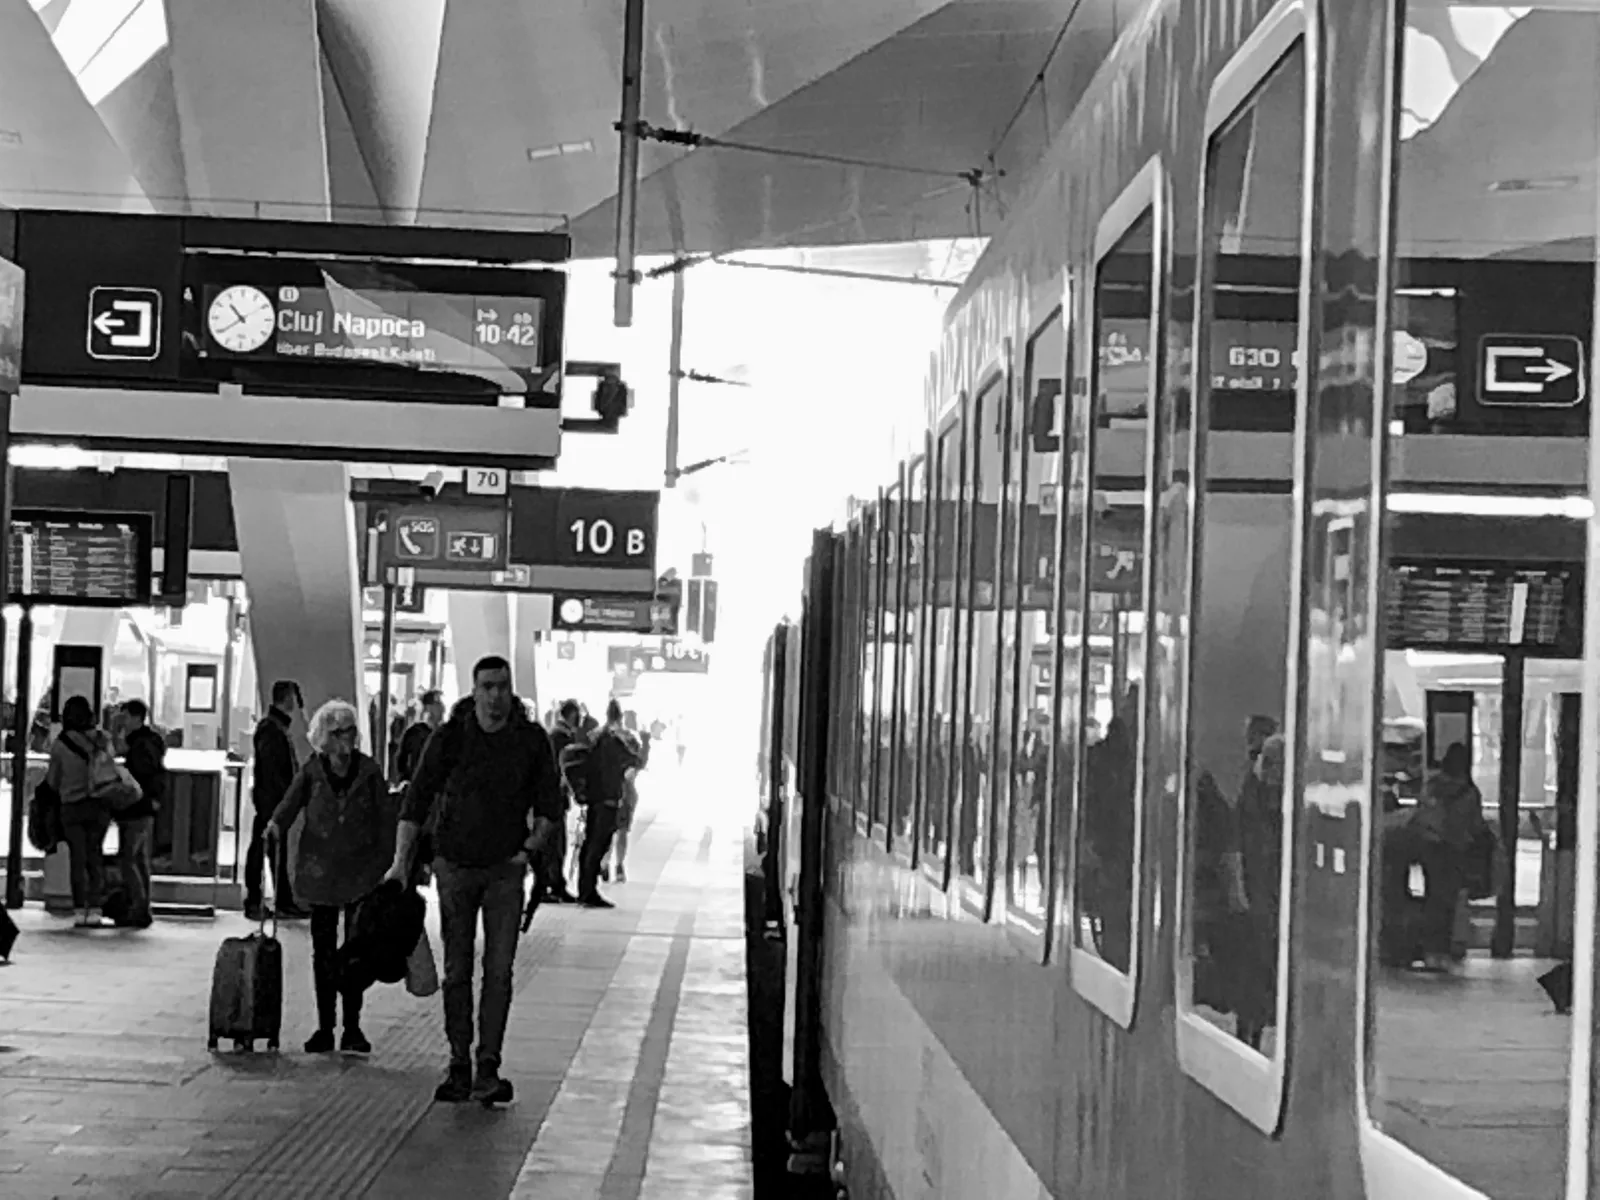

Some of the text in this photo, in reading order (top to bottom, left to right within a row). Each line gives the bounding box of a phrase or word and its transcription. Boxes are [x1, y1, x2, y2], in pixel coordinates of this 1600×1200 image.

[277, 309, 426, 340] Cluj Napoca
[476, 323, 535, 346] 10:42
[477, 471, 499, 487] 70
[570, 518, 645, 555] 10 B
